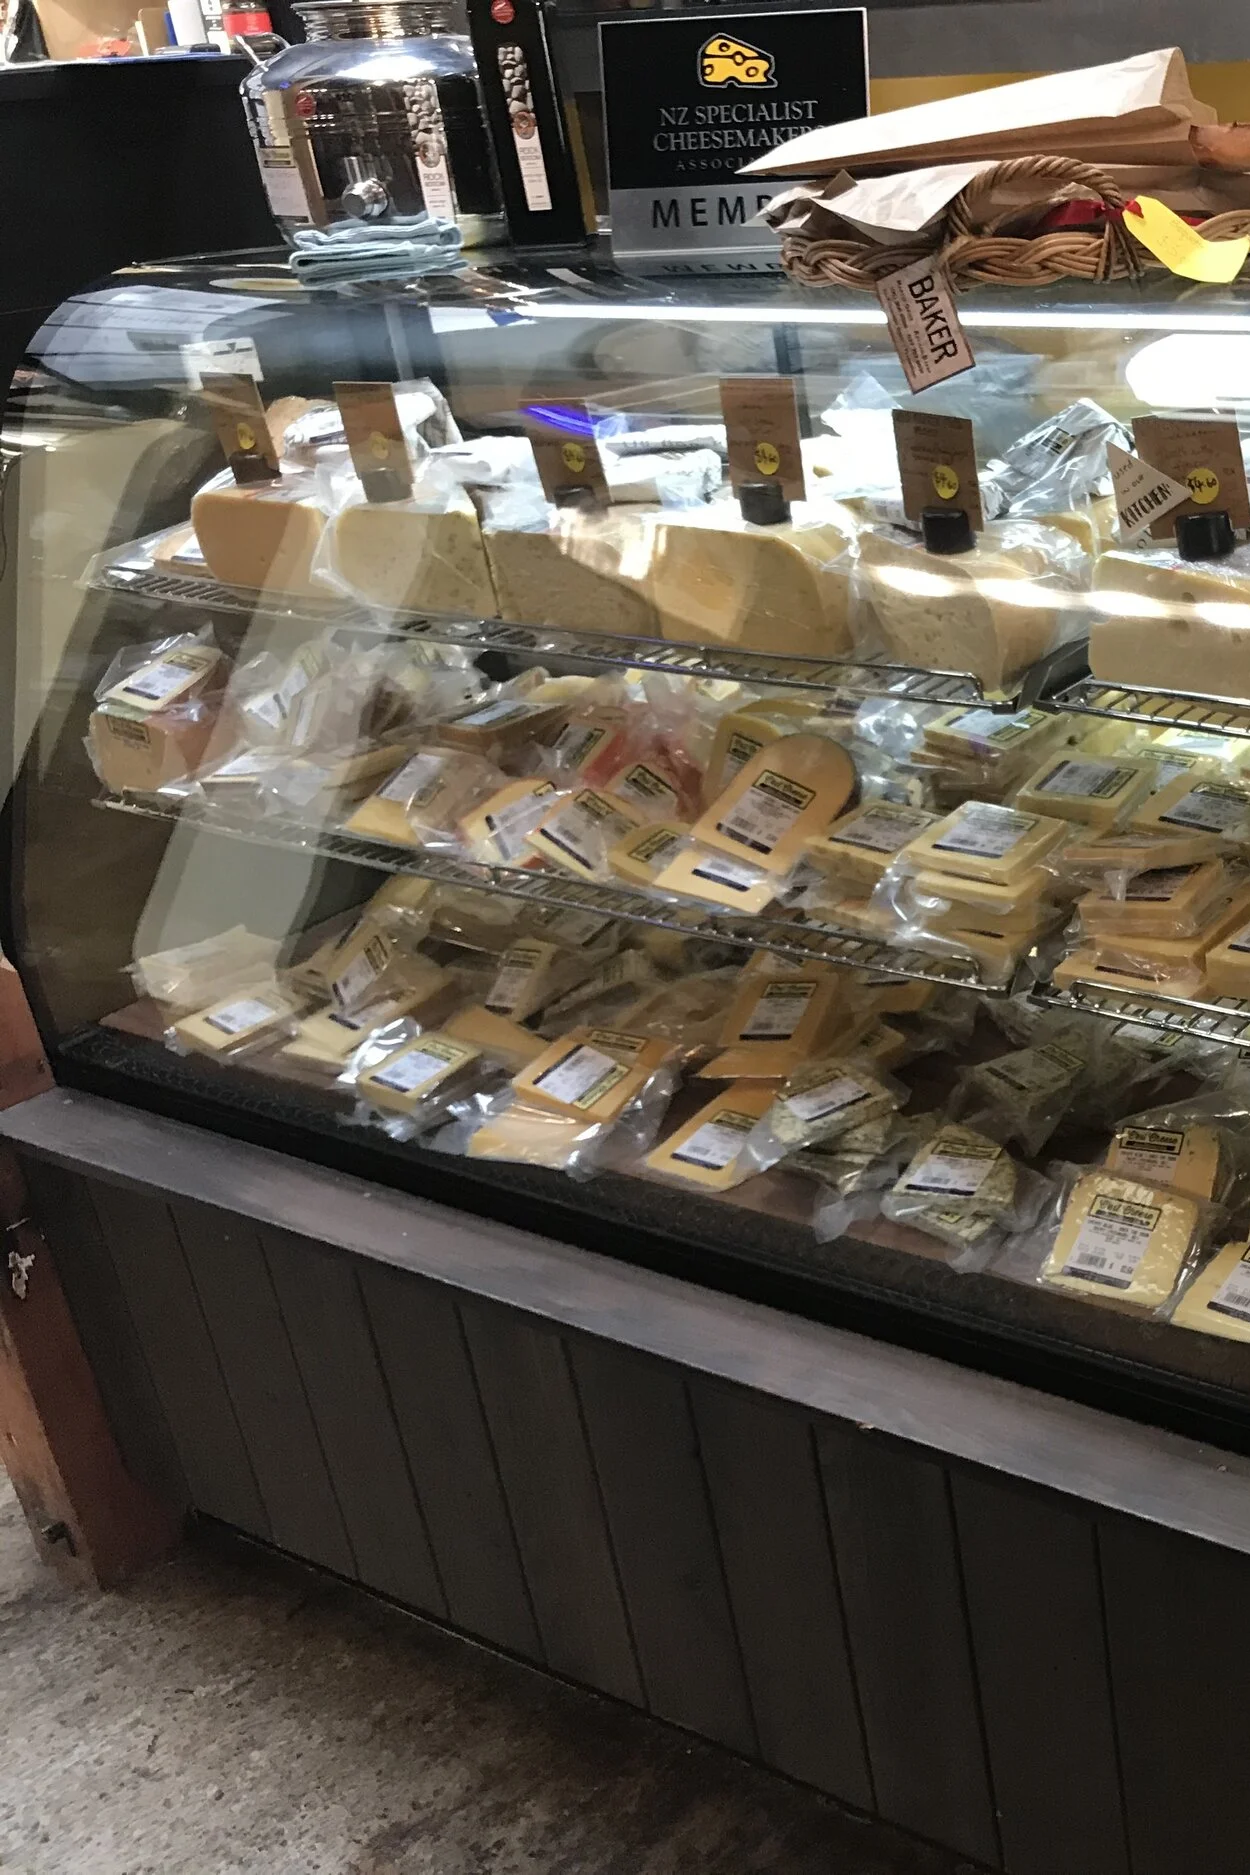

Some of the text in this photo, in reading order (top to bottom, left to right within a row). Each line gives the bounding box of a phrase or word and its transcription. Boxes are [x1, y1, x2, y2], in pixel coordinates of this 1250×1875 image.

[659, 100, 819, 127] NZ SPECIALIST
[908, 275, 958, 364] BAKER
